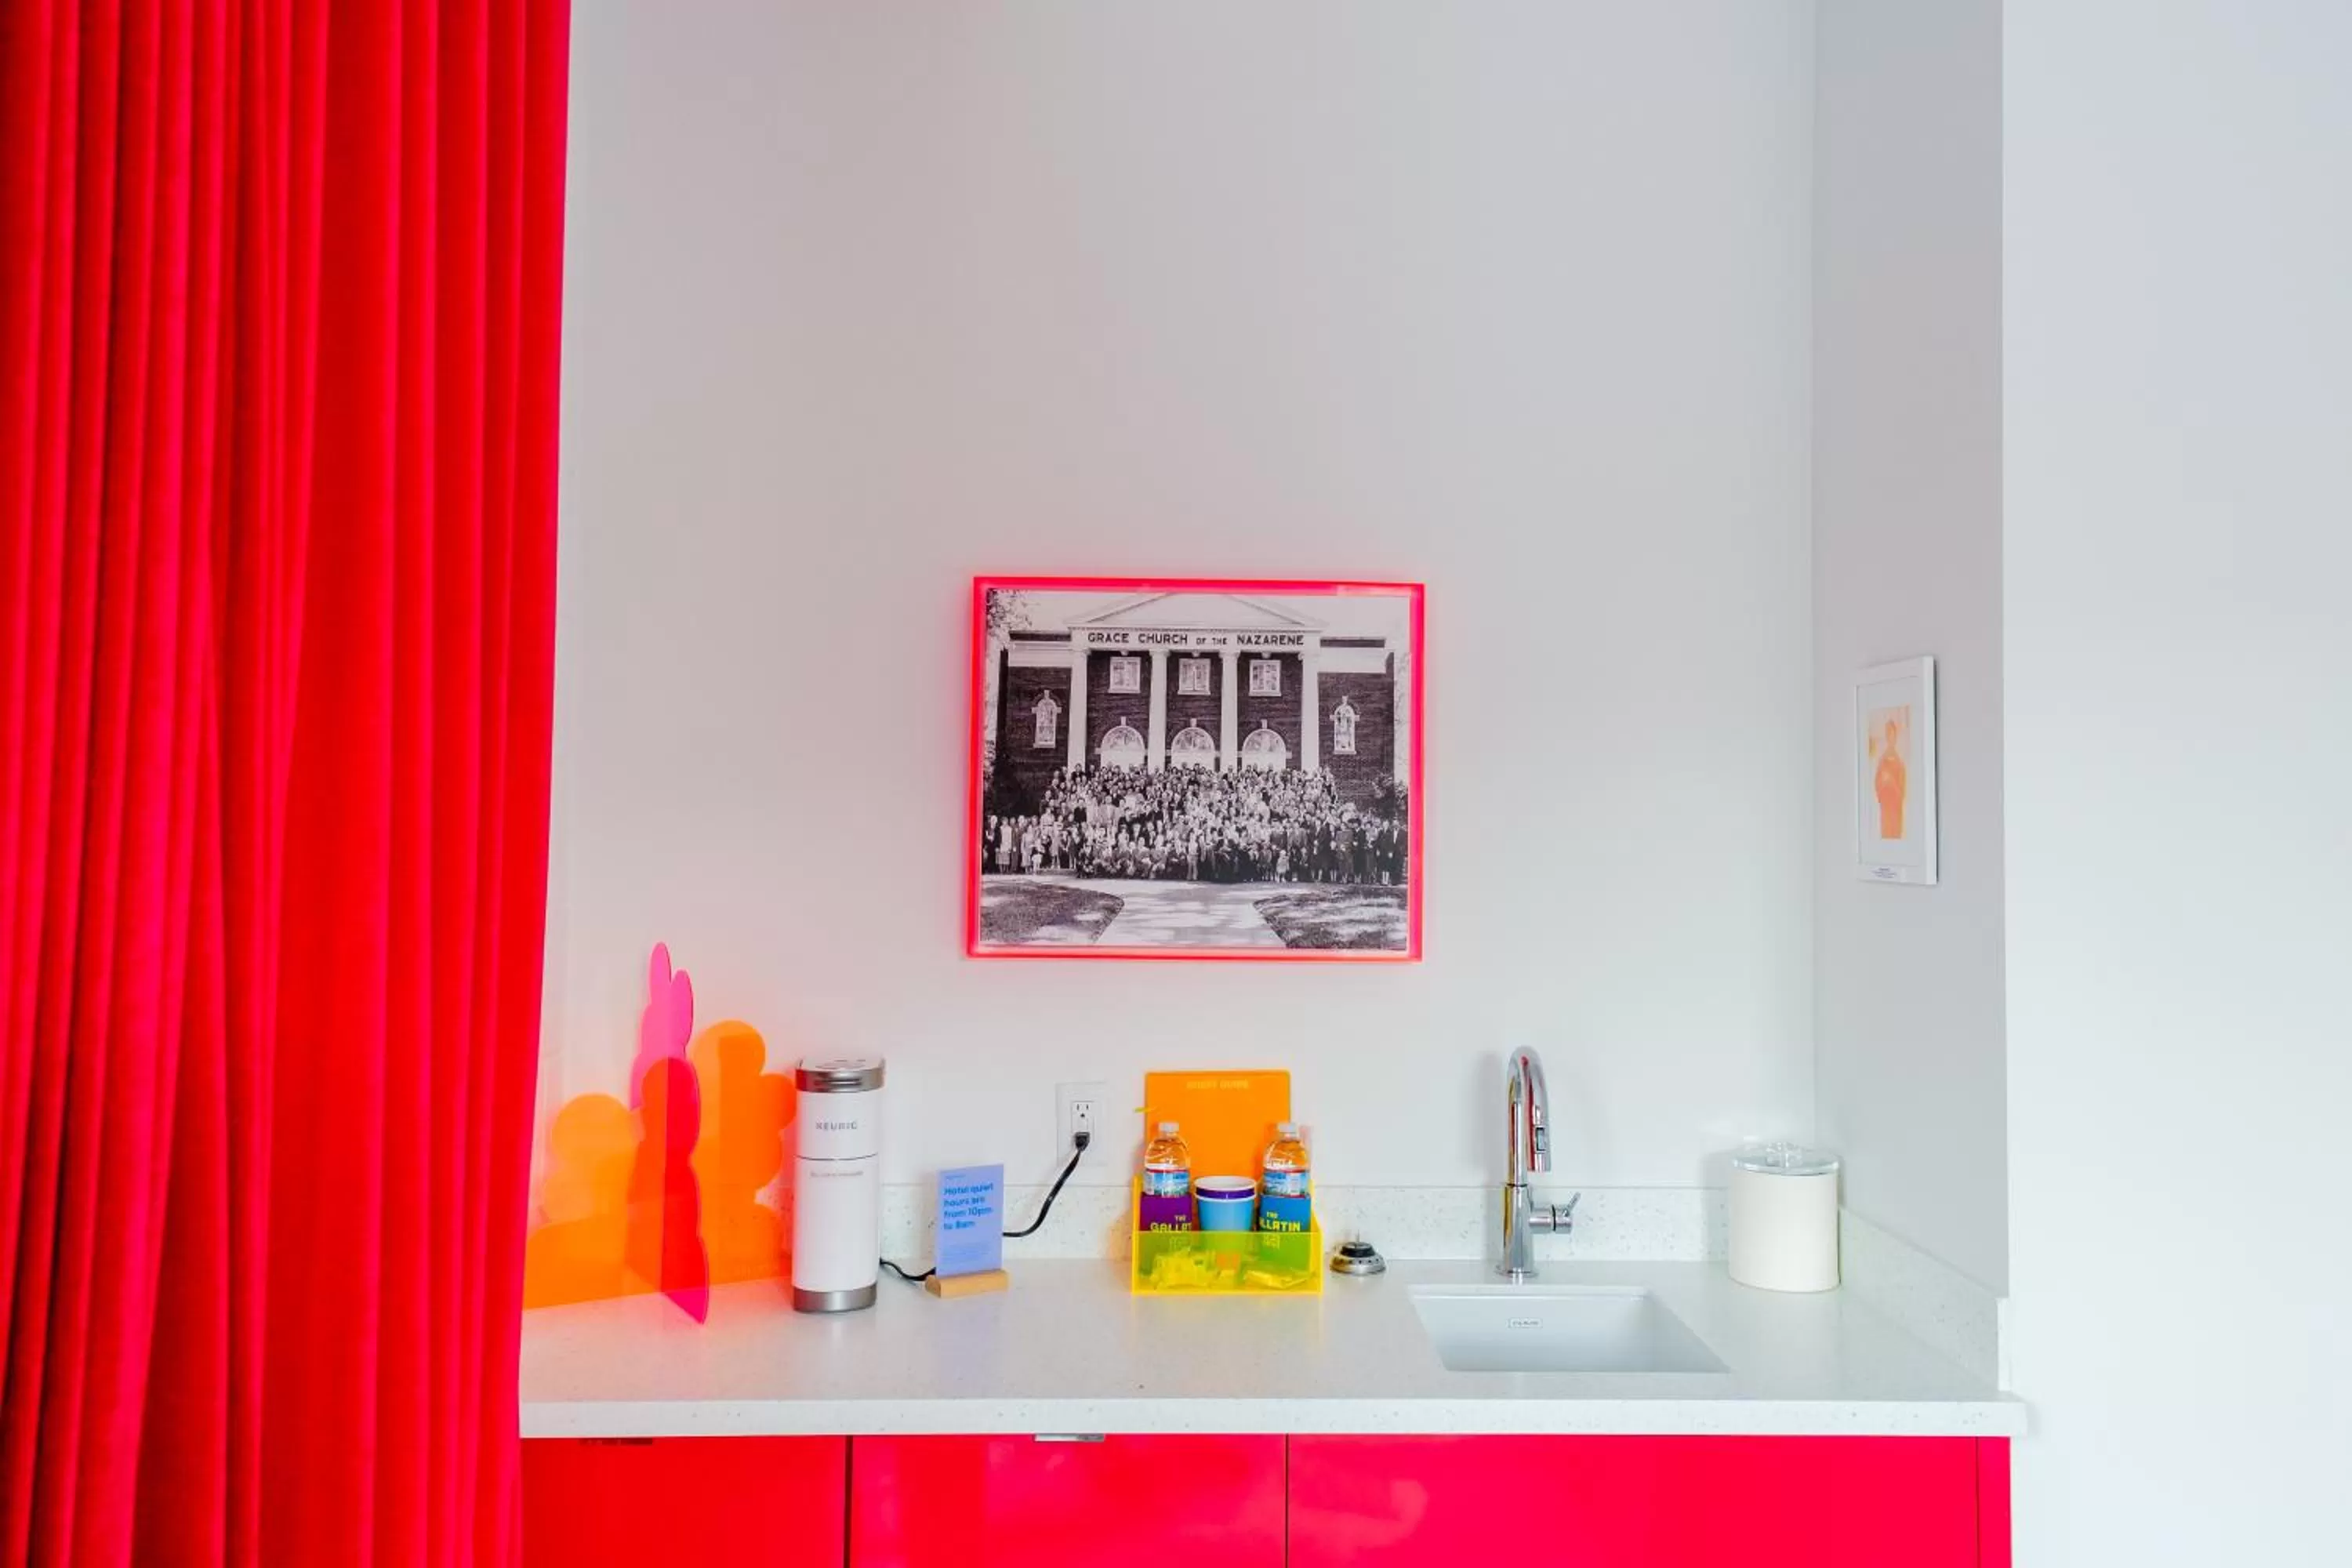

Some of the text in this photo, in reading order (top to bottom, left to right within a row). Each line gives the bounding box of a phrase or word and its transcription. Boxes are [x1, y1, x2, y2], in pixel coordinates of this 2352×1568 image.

[1087, 633, 1130, 644] GRACE
[1138, 633, 1189, 644] CHURCH
[1236, 634, 1305, 645] NAZARENE
